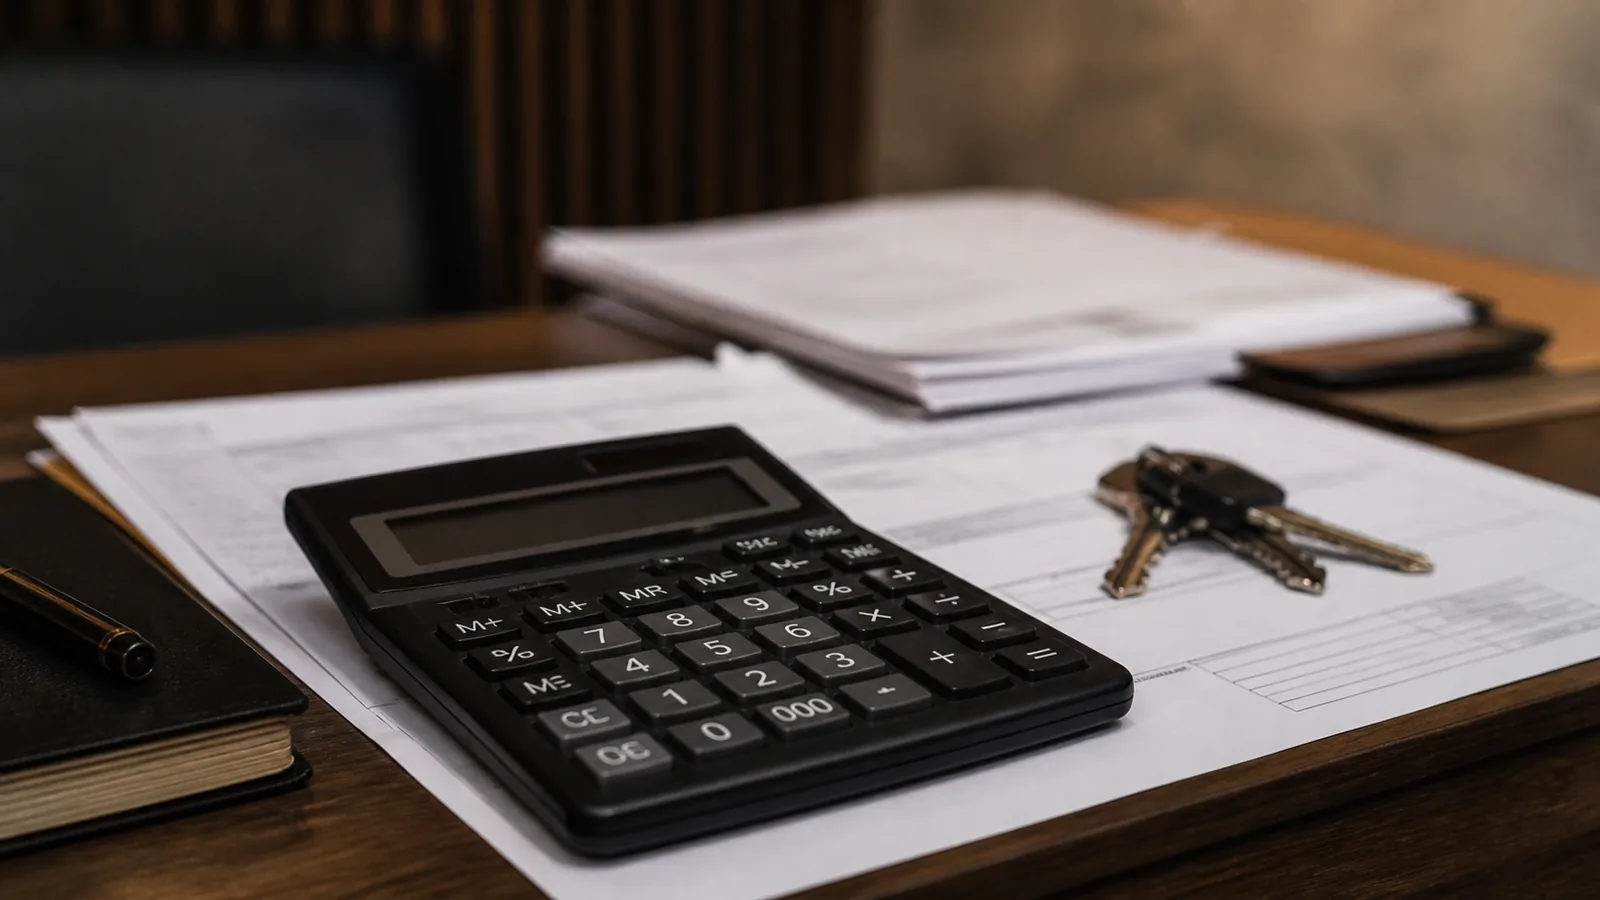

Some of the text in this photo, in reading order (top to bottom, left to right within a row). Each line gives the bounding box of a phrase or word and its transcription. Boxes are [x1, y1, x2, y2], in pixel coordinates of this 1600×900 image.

[618, 584, 668, 602] MR
[812, 581, 853, 597] %
[539, 600, 587, 617] M+
[742, 596, 770, 611] 9
[455, 618, 503, 634] M+
[665, 612, 694, 627] 8
[583, 627, 607, 644] 7
[784, 623, 812, 638] 6
[491, 645, 535, 662] %
[702, 639, 733, 656] 5
[625, 657, 650, 673] 4
[825, 652, 856, 668] 3
[744, 669, 777, 688] 2
[662, 688, 688, 706] 1
[560, 707, 611, 729] CE
[771, 697, 834, 723] 000
[701, 721, 732, 741] 0
